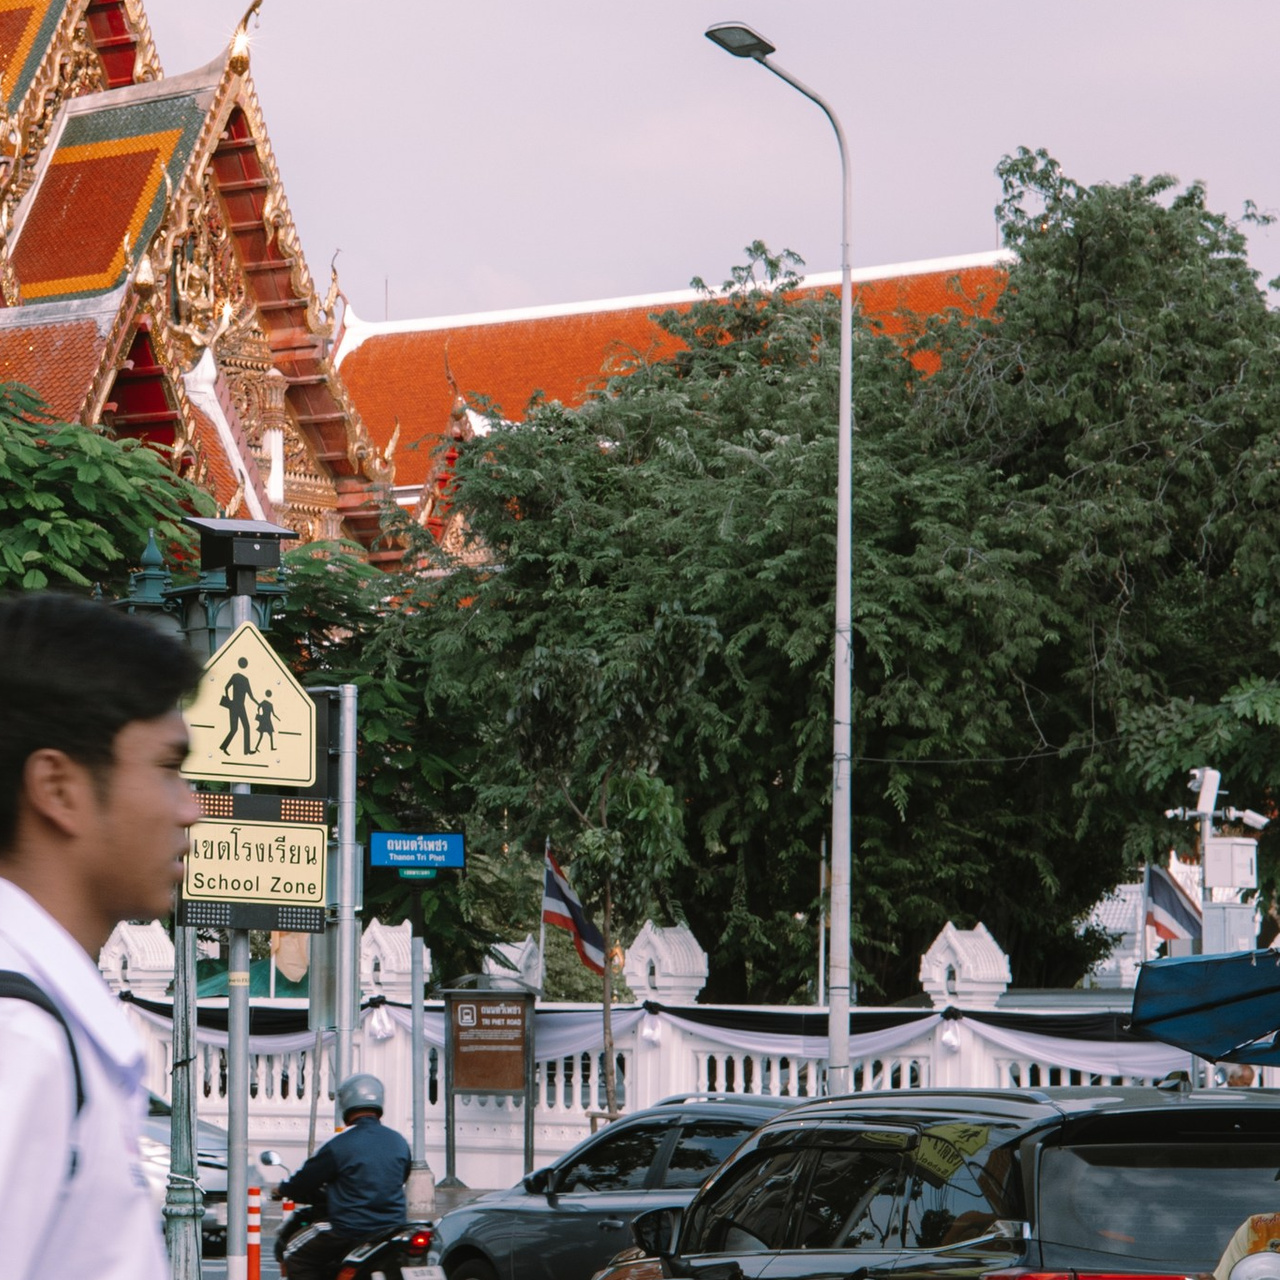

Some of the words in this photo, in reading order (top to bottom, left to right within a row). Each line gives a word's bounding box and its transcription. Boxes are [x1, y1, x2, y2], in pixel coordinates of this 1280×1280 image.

[193, 827, 318, 865] เขตโรงเรียน
[386, 835, 448, 852] ถนนตรีเพชร
[389, 853, 415, 861] Thanon
[416, 853, 427, 861] Tri
[428, 853, 446, 862] Phet
[193, 872, 260, 892] School
[270, 876, 317, 895] Zone
